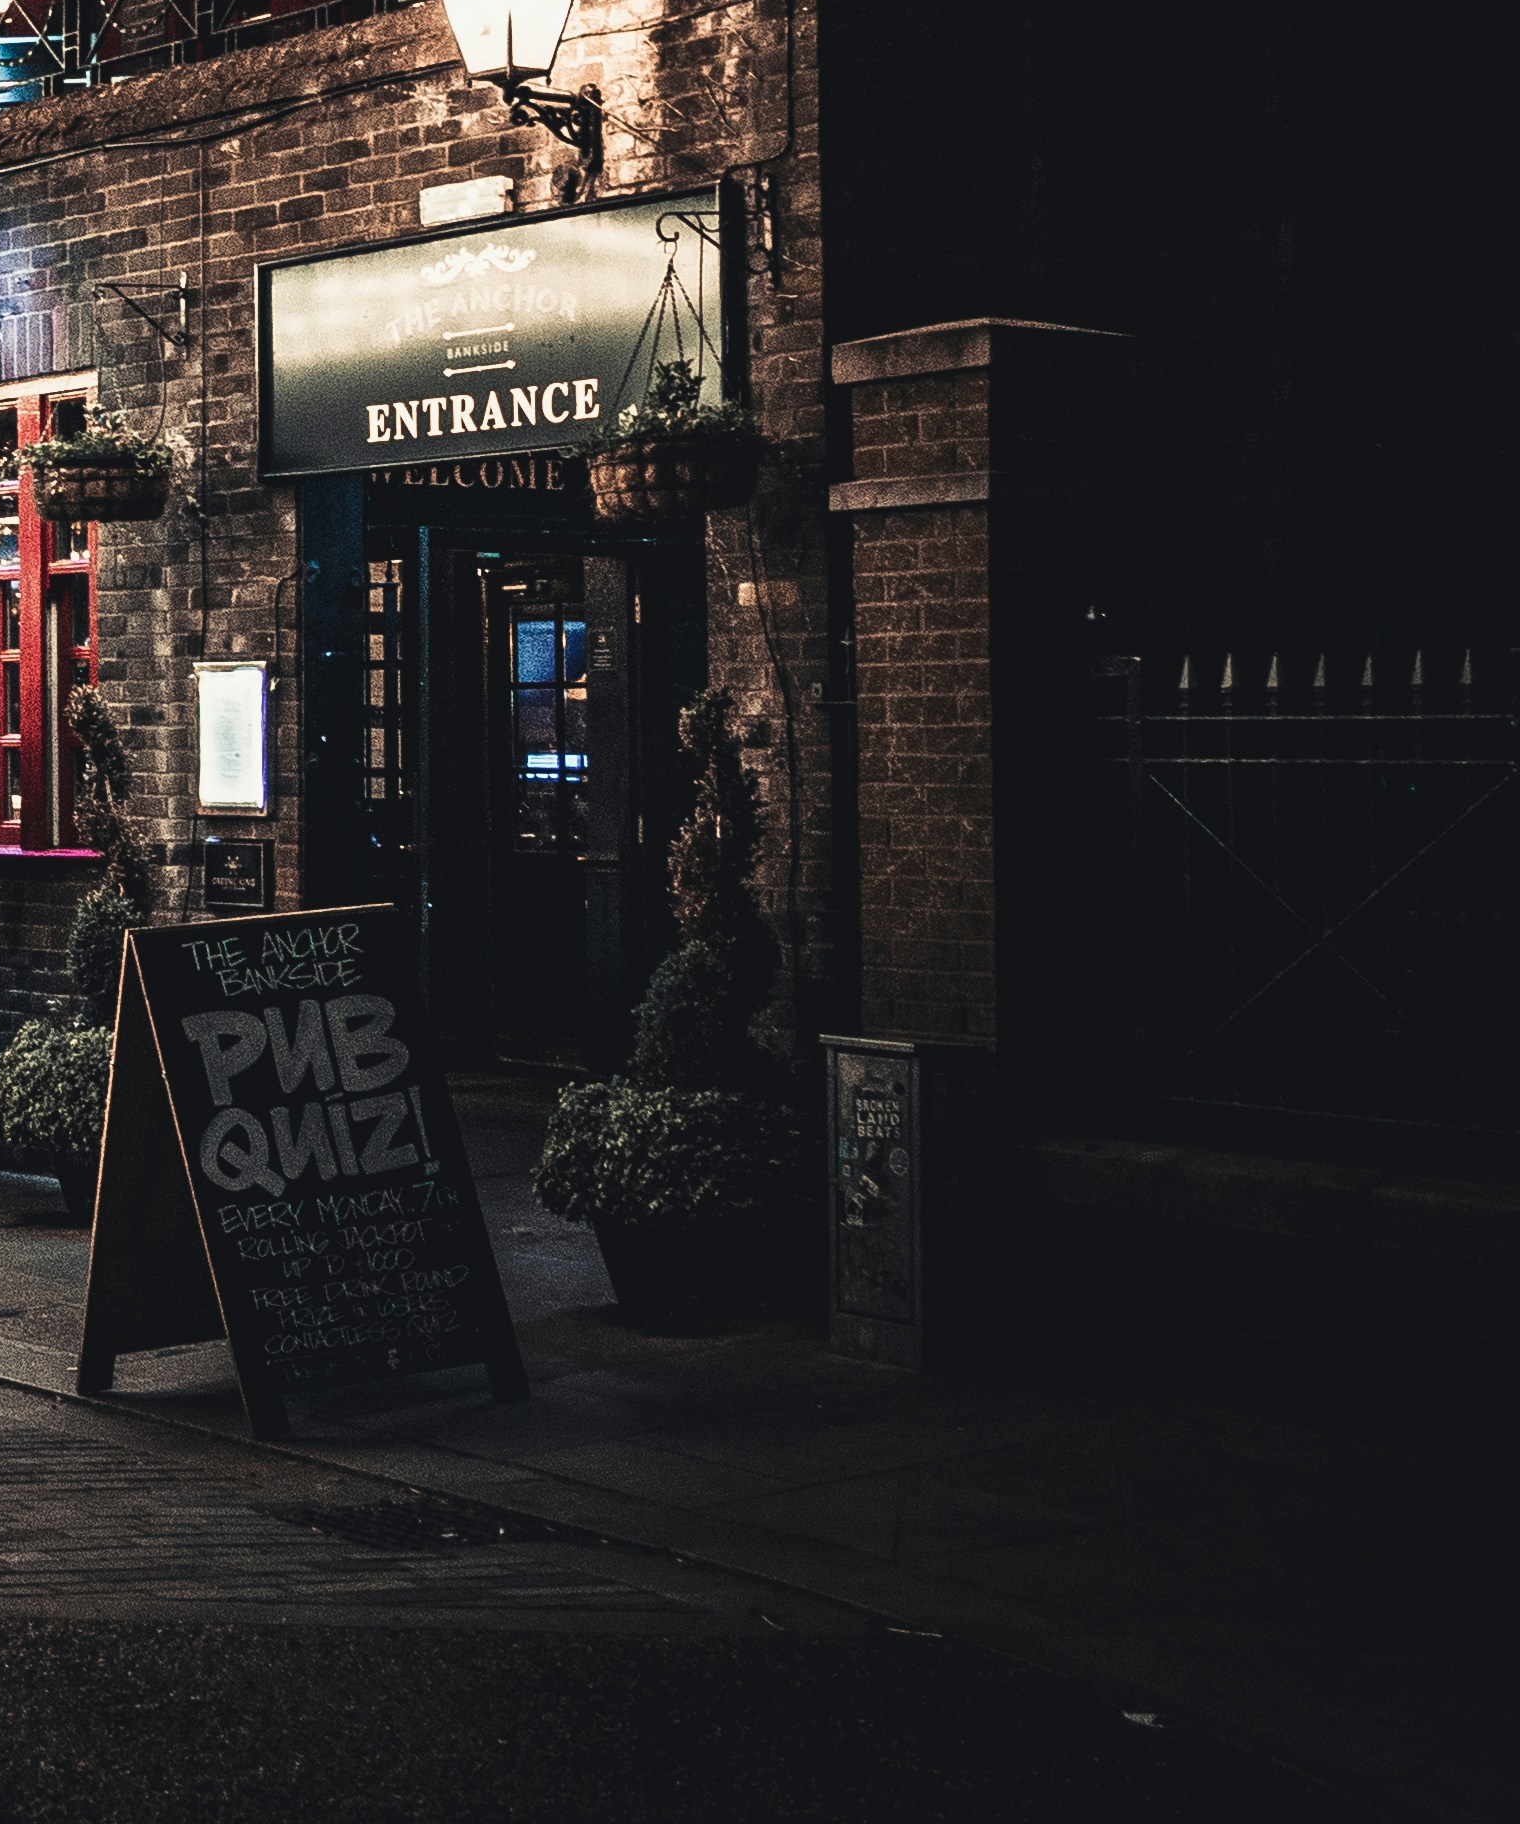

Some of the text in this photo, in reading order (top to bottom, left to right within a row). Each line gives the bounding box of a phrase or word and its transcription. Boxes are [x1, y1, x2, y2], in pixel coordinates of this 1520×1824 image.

[386, 284, 578, 344] THE ANCHOR
[446, 339, 511, 360] BANKSIDE
[365, 377, 602, 444] ENTRANCE
[181, 922, 365, 973] THE ANCHOR
[215, 958, 363, 997] BANKSIDE
[180, 992, 412, 1108] PUB
[216, 1198, 305, 1235] EVERY
[281, 1255, 313, 1280] UP
[249, 1284, 313, 1311] FREE
